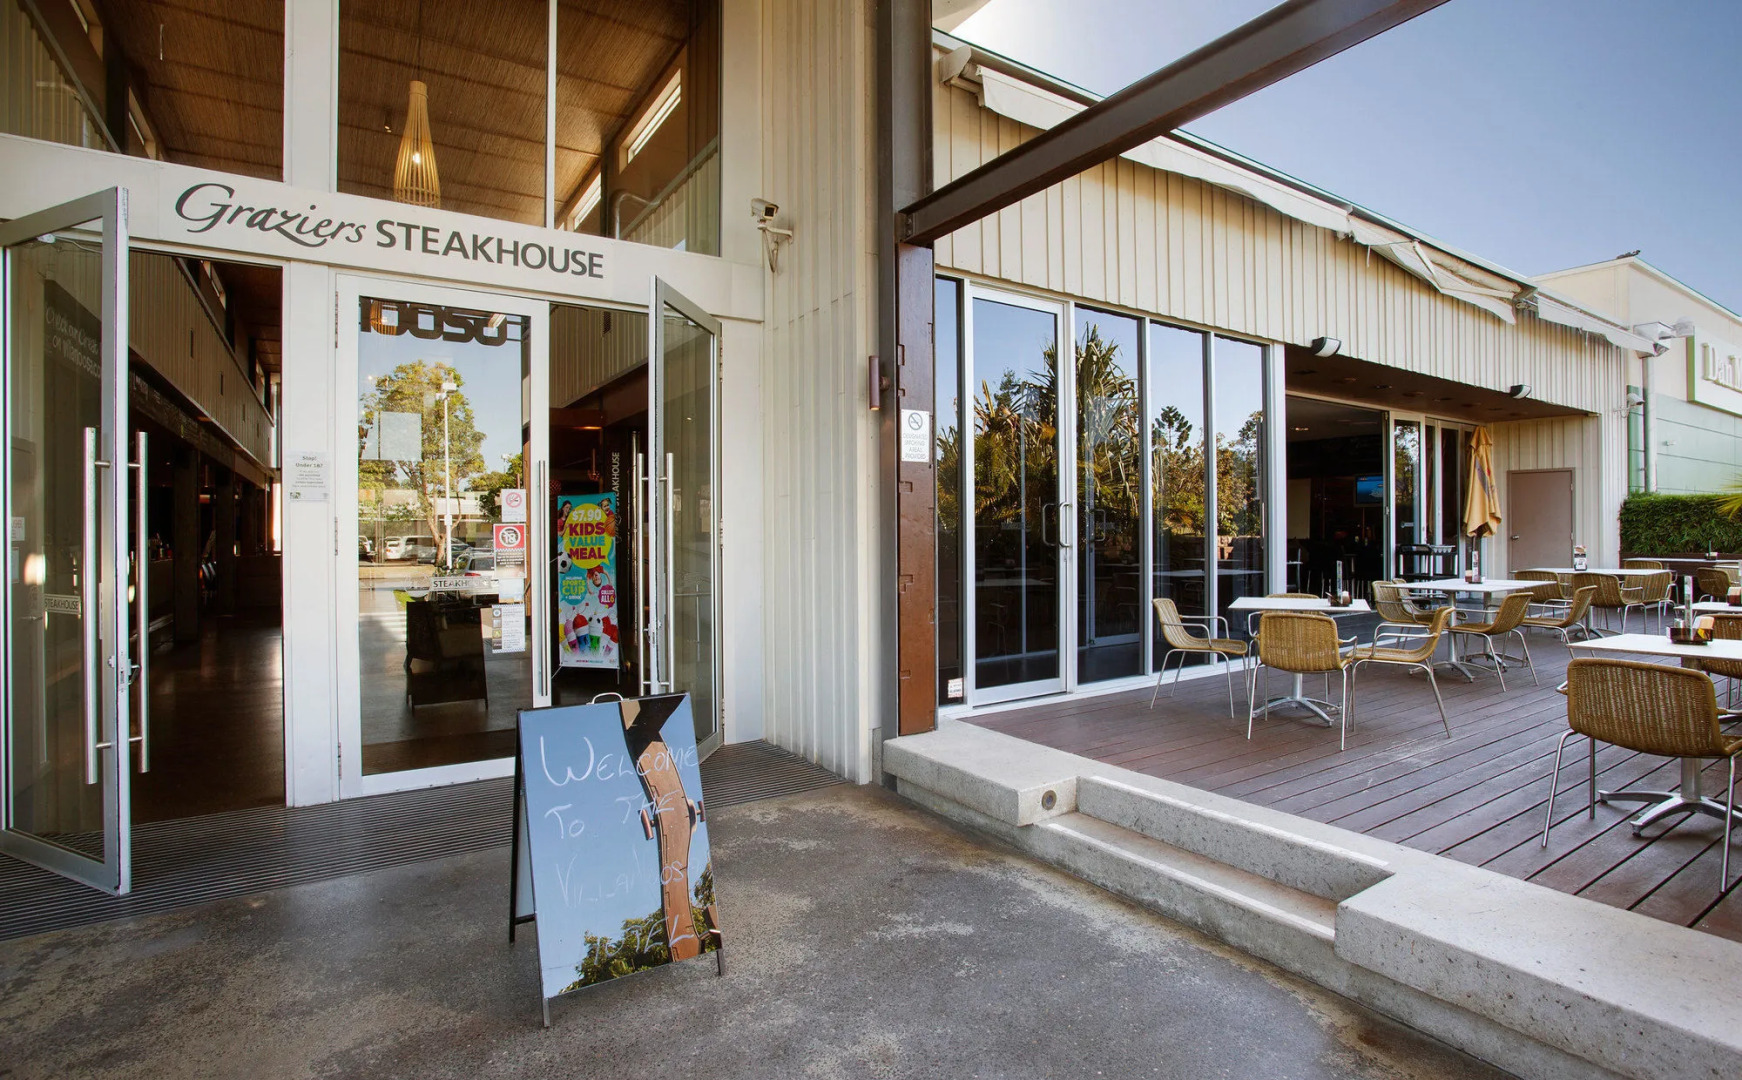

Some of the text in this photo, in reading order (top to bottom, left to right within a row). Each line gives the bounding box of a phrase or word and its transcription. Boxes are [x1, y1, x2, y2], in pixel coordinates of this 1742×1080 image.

[175, 182, 604, 280] Graziers STEAKHOUSE
[572, 508, 602, 522] $7.90
[568, 522, 606, 536] KIDS
[504, 533, 517, 543] 18
[568, 536, 606, 547] VALUE
[568, 547, 606, 560] MEAL
[562, 586, 586, 596] CUP
[44, 598, 79, 611] STEAKHOUSE
[539, 735, 698, 787] WELCOME
[615, 788, 681, 825] THE
